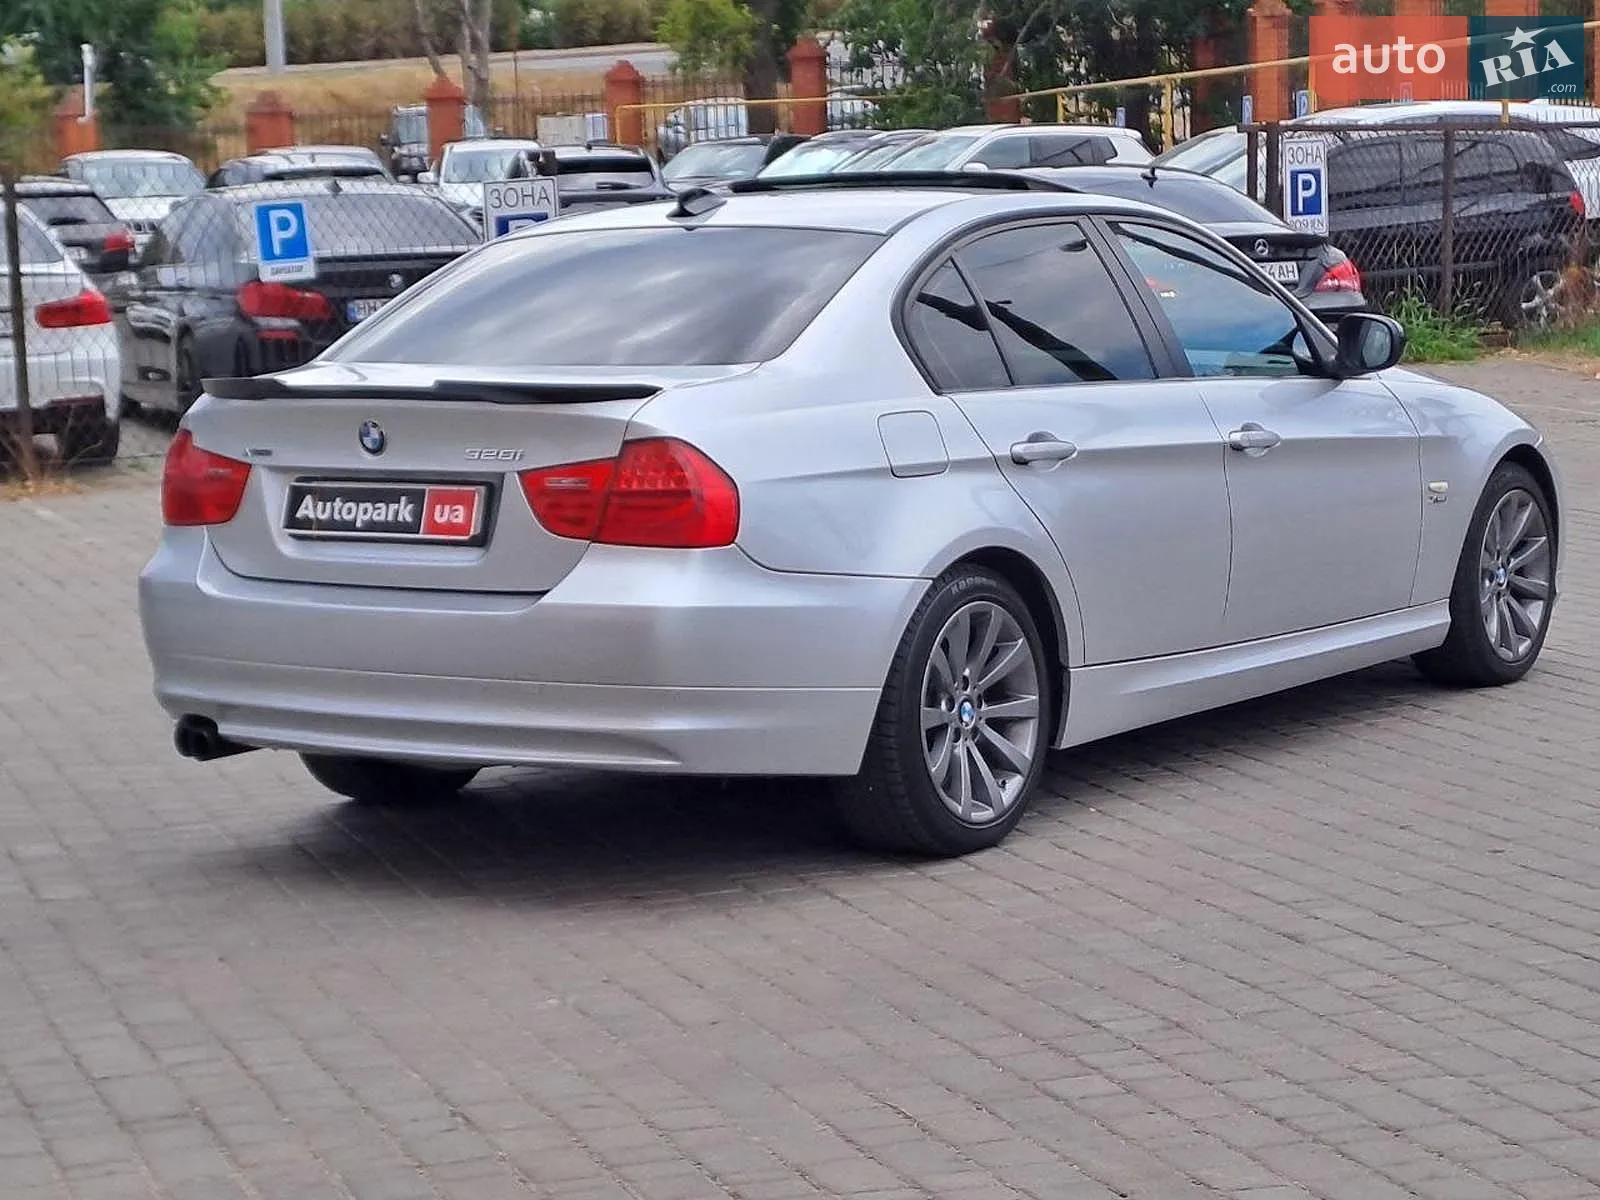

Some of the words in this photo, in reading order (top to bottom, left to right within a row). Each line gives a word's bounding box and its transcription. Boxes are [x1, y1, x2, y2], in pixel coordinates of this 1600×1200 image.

[1287, 145, 1323, 165] ЗОНА
[489, 185, 551, 209] ЗОНА
[1297, 172, 1317, 213] P
[268, 208, 298, 256] P
[295, 494, 414, 528] Autopark
[433, 503, 465, 524] ua
